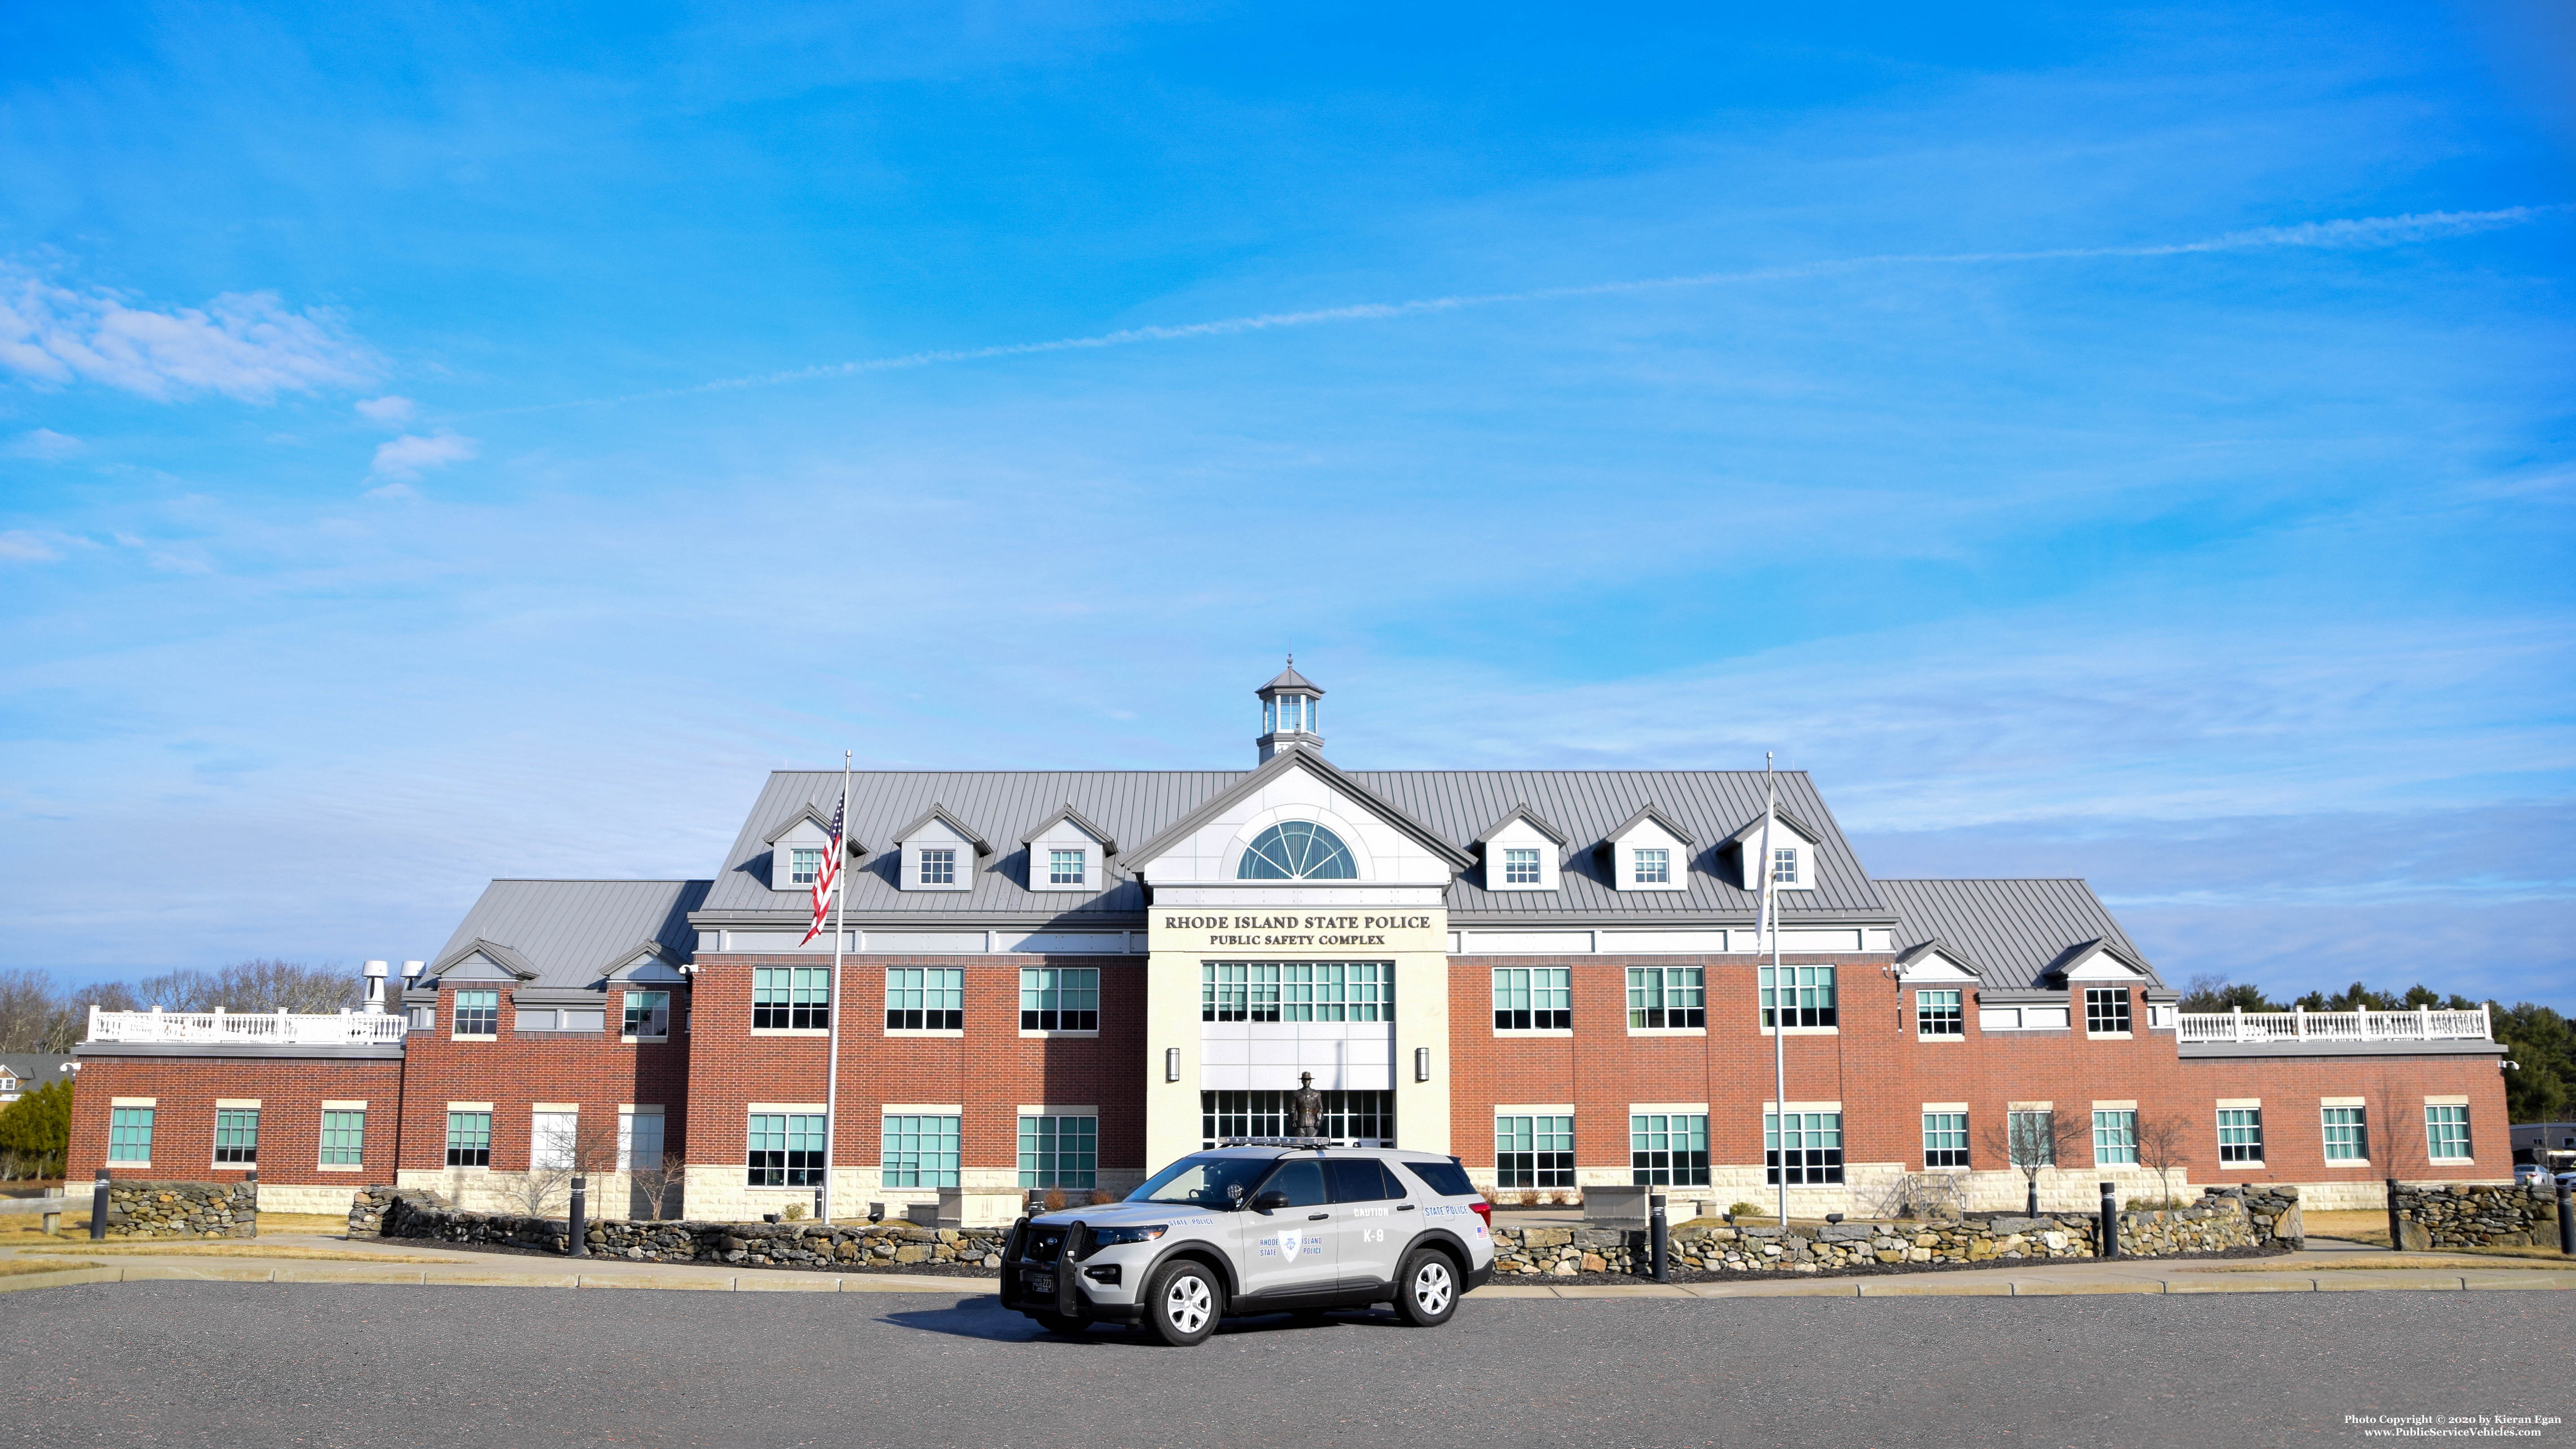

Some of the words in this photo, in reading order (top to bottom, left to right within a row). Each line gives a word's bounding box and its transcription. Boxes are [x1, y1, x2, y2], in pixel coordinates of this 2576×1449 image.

[1165, 916, 1229, 928] RHODE
[1235, 916, 1299, 928] ISLAND
[1305, 916, 1359, 928] STATE
[1364, 916, 1431, 928] POLICE
[1210, 935, 1260, 945] PUBLIC
[1265, 935, 1315, 945] SAFETY
[1319, 935, 1385, 945] COMPLEX
[1354, 1207, 1388, 1217] CAUTION
[1425, 1207, 1444, 1216] STATE
[1446, 1205, 1468, 1215] POLICE
[1364, 1229, 1384, 1242] K-9
[1043, 1279, 1052, 1288] 223
